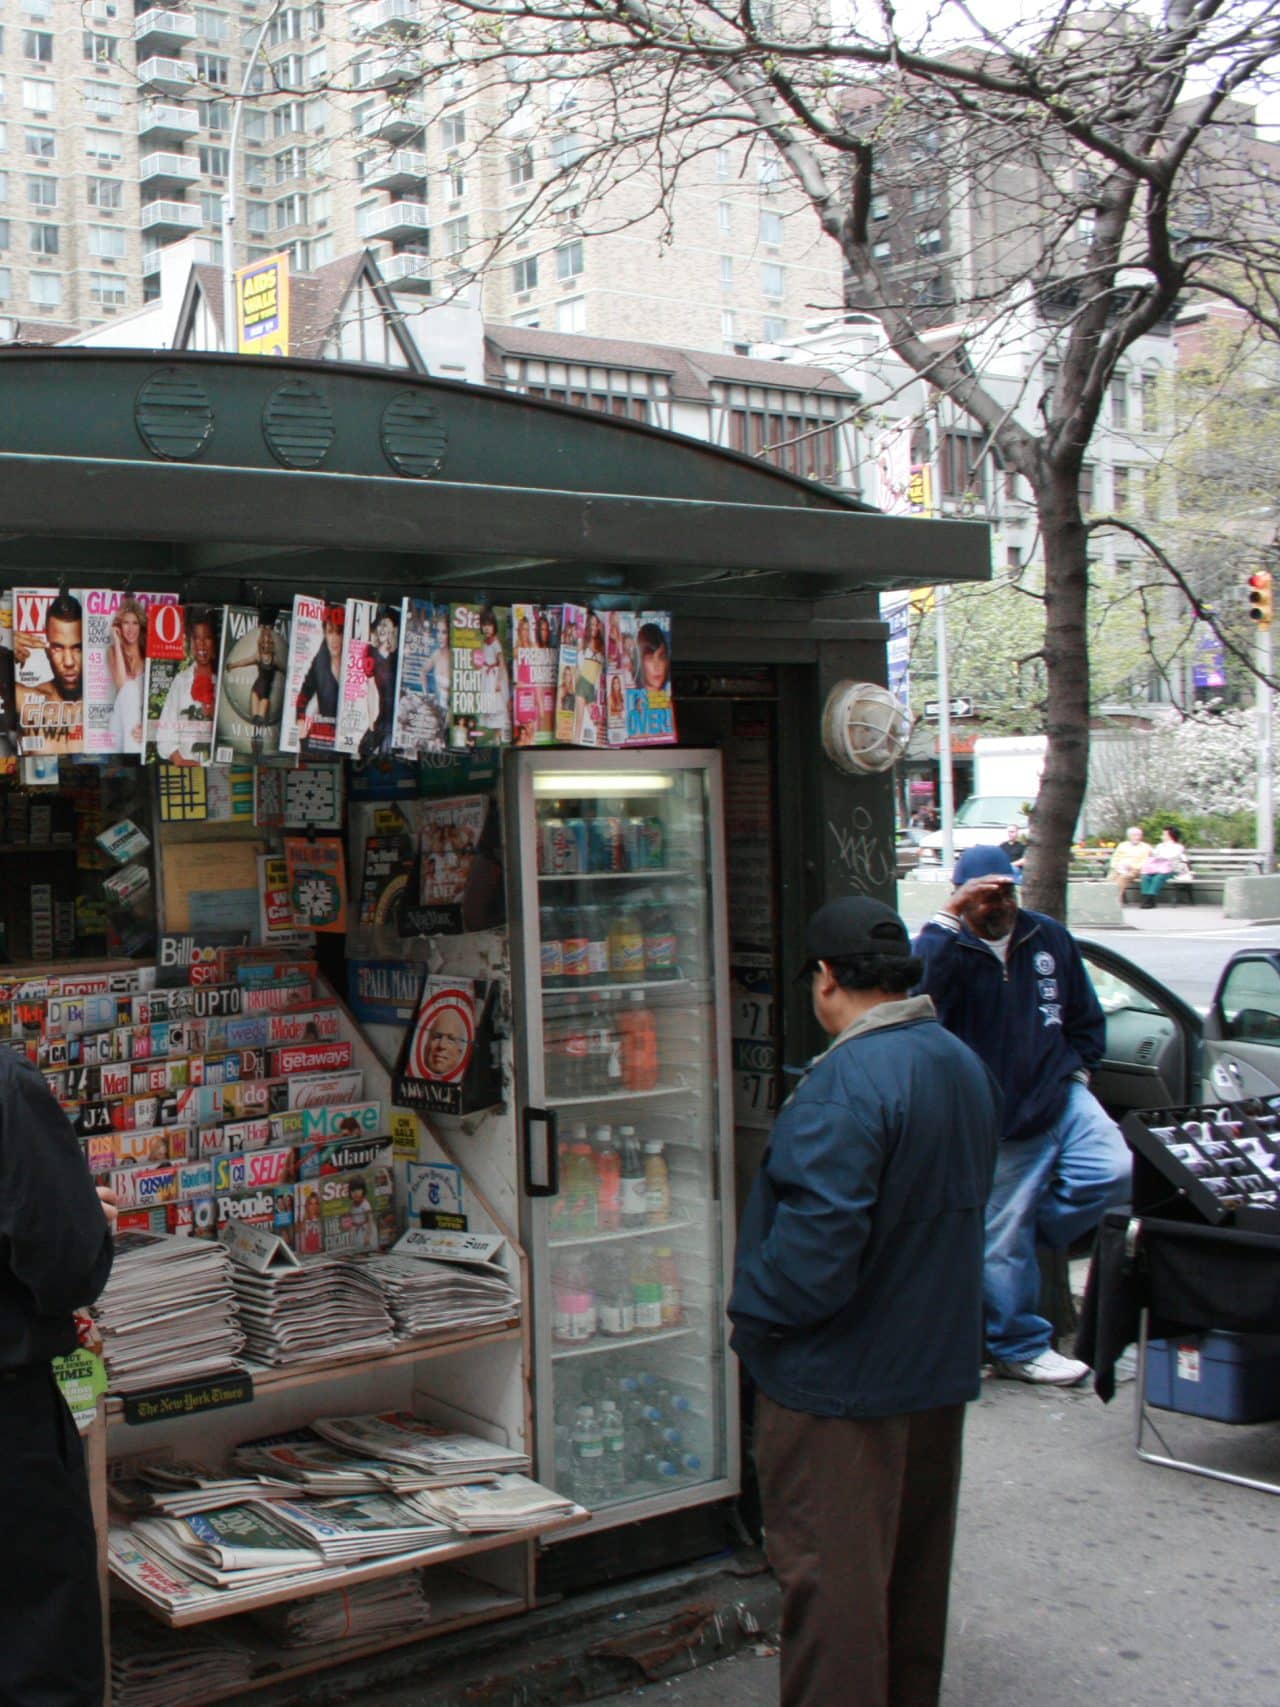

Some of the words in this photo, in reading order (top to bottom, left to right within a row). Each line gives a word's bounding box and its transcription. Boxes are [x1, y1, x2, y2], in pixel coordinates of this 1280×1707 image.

[243, 269, 277, 298] AIDS
[243, 288, 277, 316] WALK
[86, 591, 179, 616] GLAOUR
[17, 597, 58, 633] XX
[153, 604, 182, 644] O
[87, 652, 102, 667] 43
[452, 649, 473, 672] THE
[452, 671, 482, 692] FIGHT
[452, 692, 472, 714] FOR
[626, 708, 673, 736] OVER!
[362, 967, 390, 999] PALL
[194, 989, 241, 1017] UPTO
[271, 1019, 303, 1041] Mode
[281, 1050, 351, 1072] getaways
[103, 1074, 129, 1096] Men
[244, 1087, 270, 1105] do
[303, 1106, 378, 1138] More
[394, 1127, 415, 1138] SALE
[397, 1118, 410, 1127] ON
[393, 1138, 417, 1149] HERE
[247, 1152, 287, 1188] SELF
[218, 1191, 274, 1222] People
[406, 1232, 432, 1246] The
[461, 1237, 489, 1251] Sun
[63, 1354, 82, 1363] BUY
[56, 1366, 94, 1382] TIMES
[139, 1402, 158, 1418] The
[160, 1398, 184, 1412] New
[184, 1393, 211, 1410] York
[212, 1387, 245, 1404] Times
